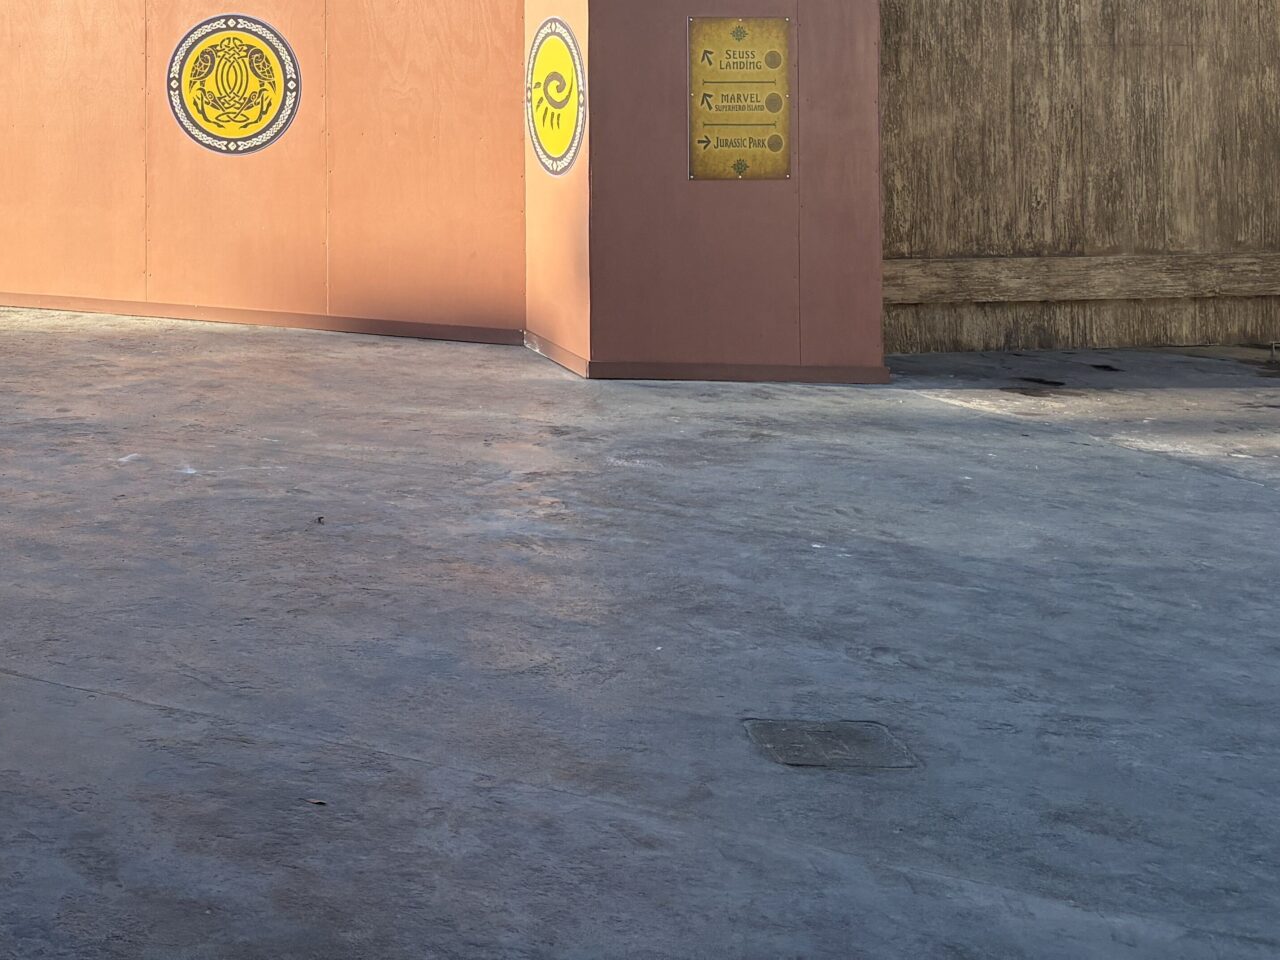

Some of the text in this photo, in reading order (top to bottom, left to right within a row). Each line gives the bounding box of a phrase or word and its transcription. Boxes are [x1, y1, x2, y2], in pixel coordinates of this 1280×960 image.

[725, 50, 756, 60] SEUSS
[719, 60, 762, 70] LANDING
[721, 93, 761, 103] MARVEL
[714, 136, 767, 149] JURASSIC PARK
